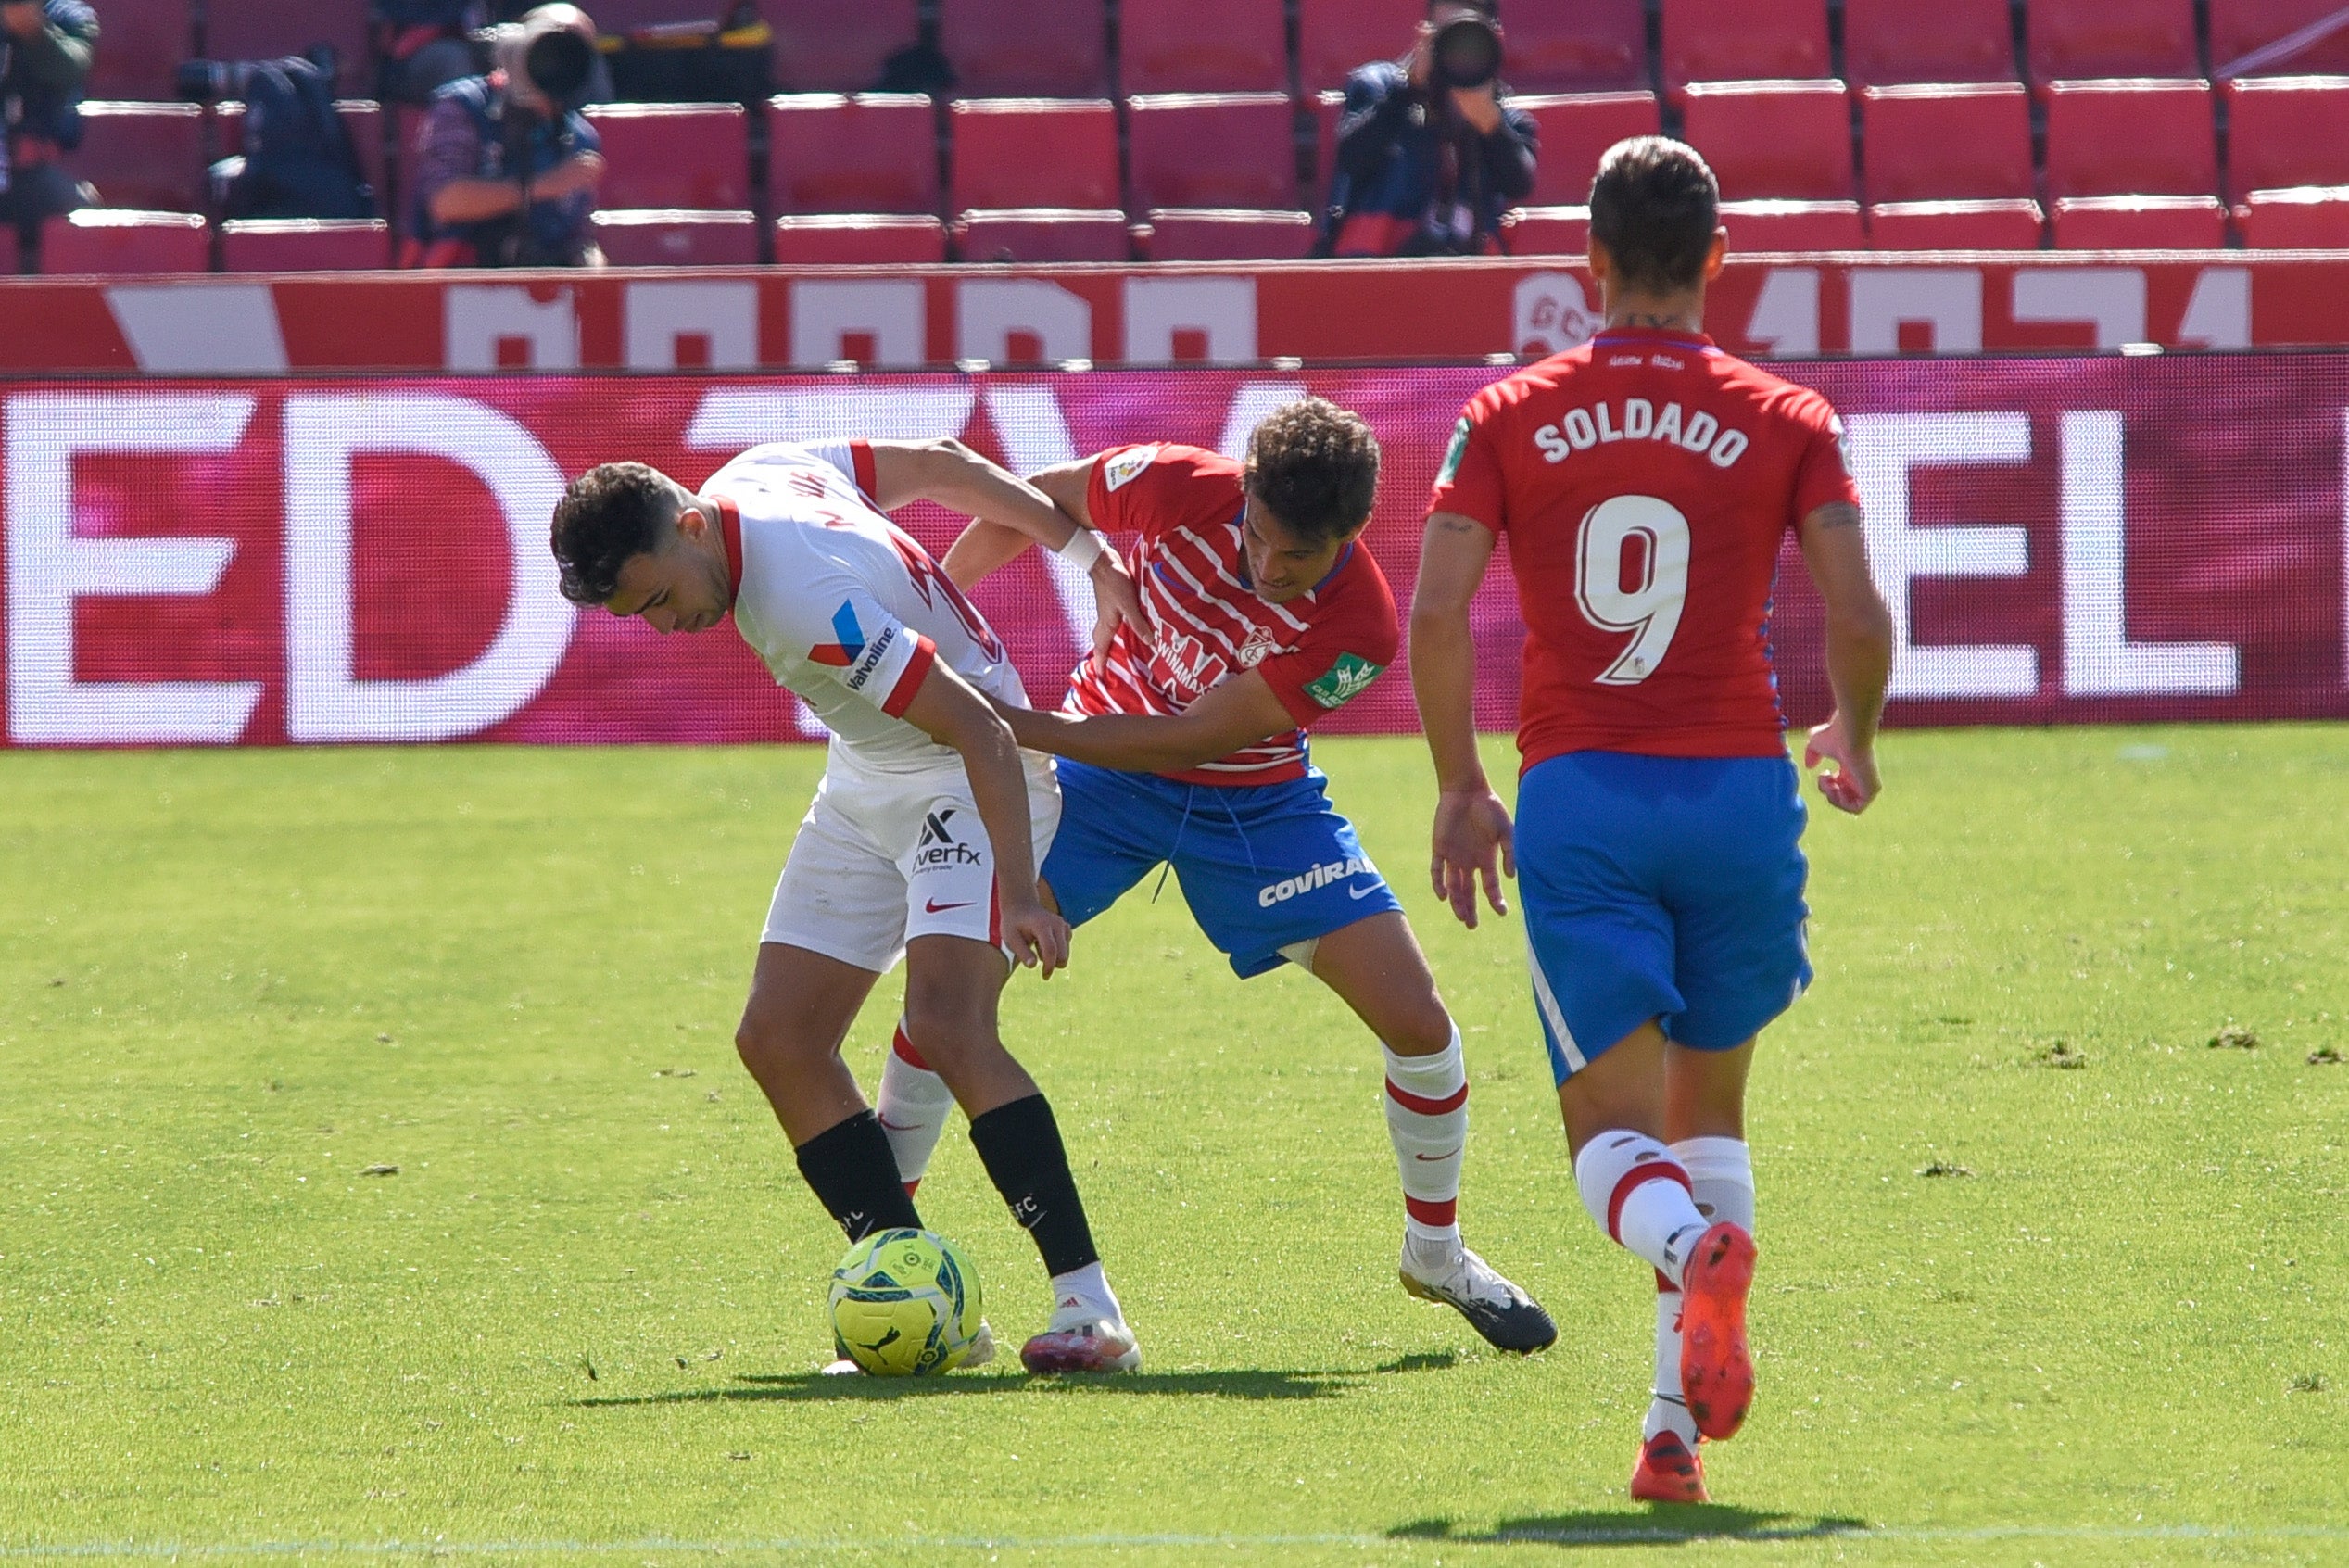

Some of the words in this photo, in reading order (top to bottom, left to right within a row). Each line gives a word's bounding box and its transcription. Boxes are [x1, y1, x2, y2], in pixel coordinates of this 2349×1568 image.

[1534, 398, 1749, 468] SOLDADO
[5, 390, 577, 743] ED
[1845, 410, 2242, 700] EL
[1575, 494, 1691, 685] 9
[847, 627, 895, 691] Valvoline
[1157, 638, 1209, 696] WINAMAX
[912, 842, 981, 872] verfx
